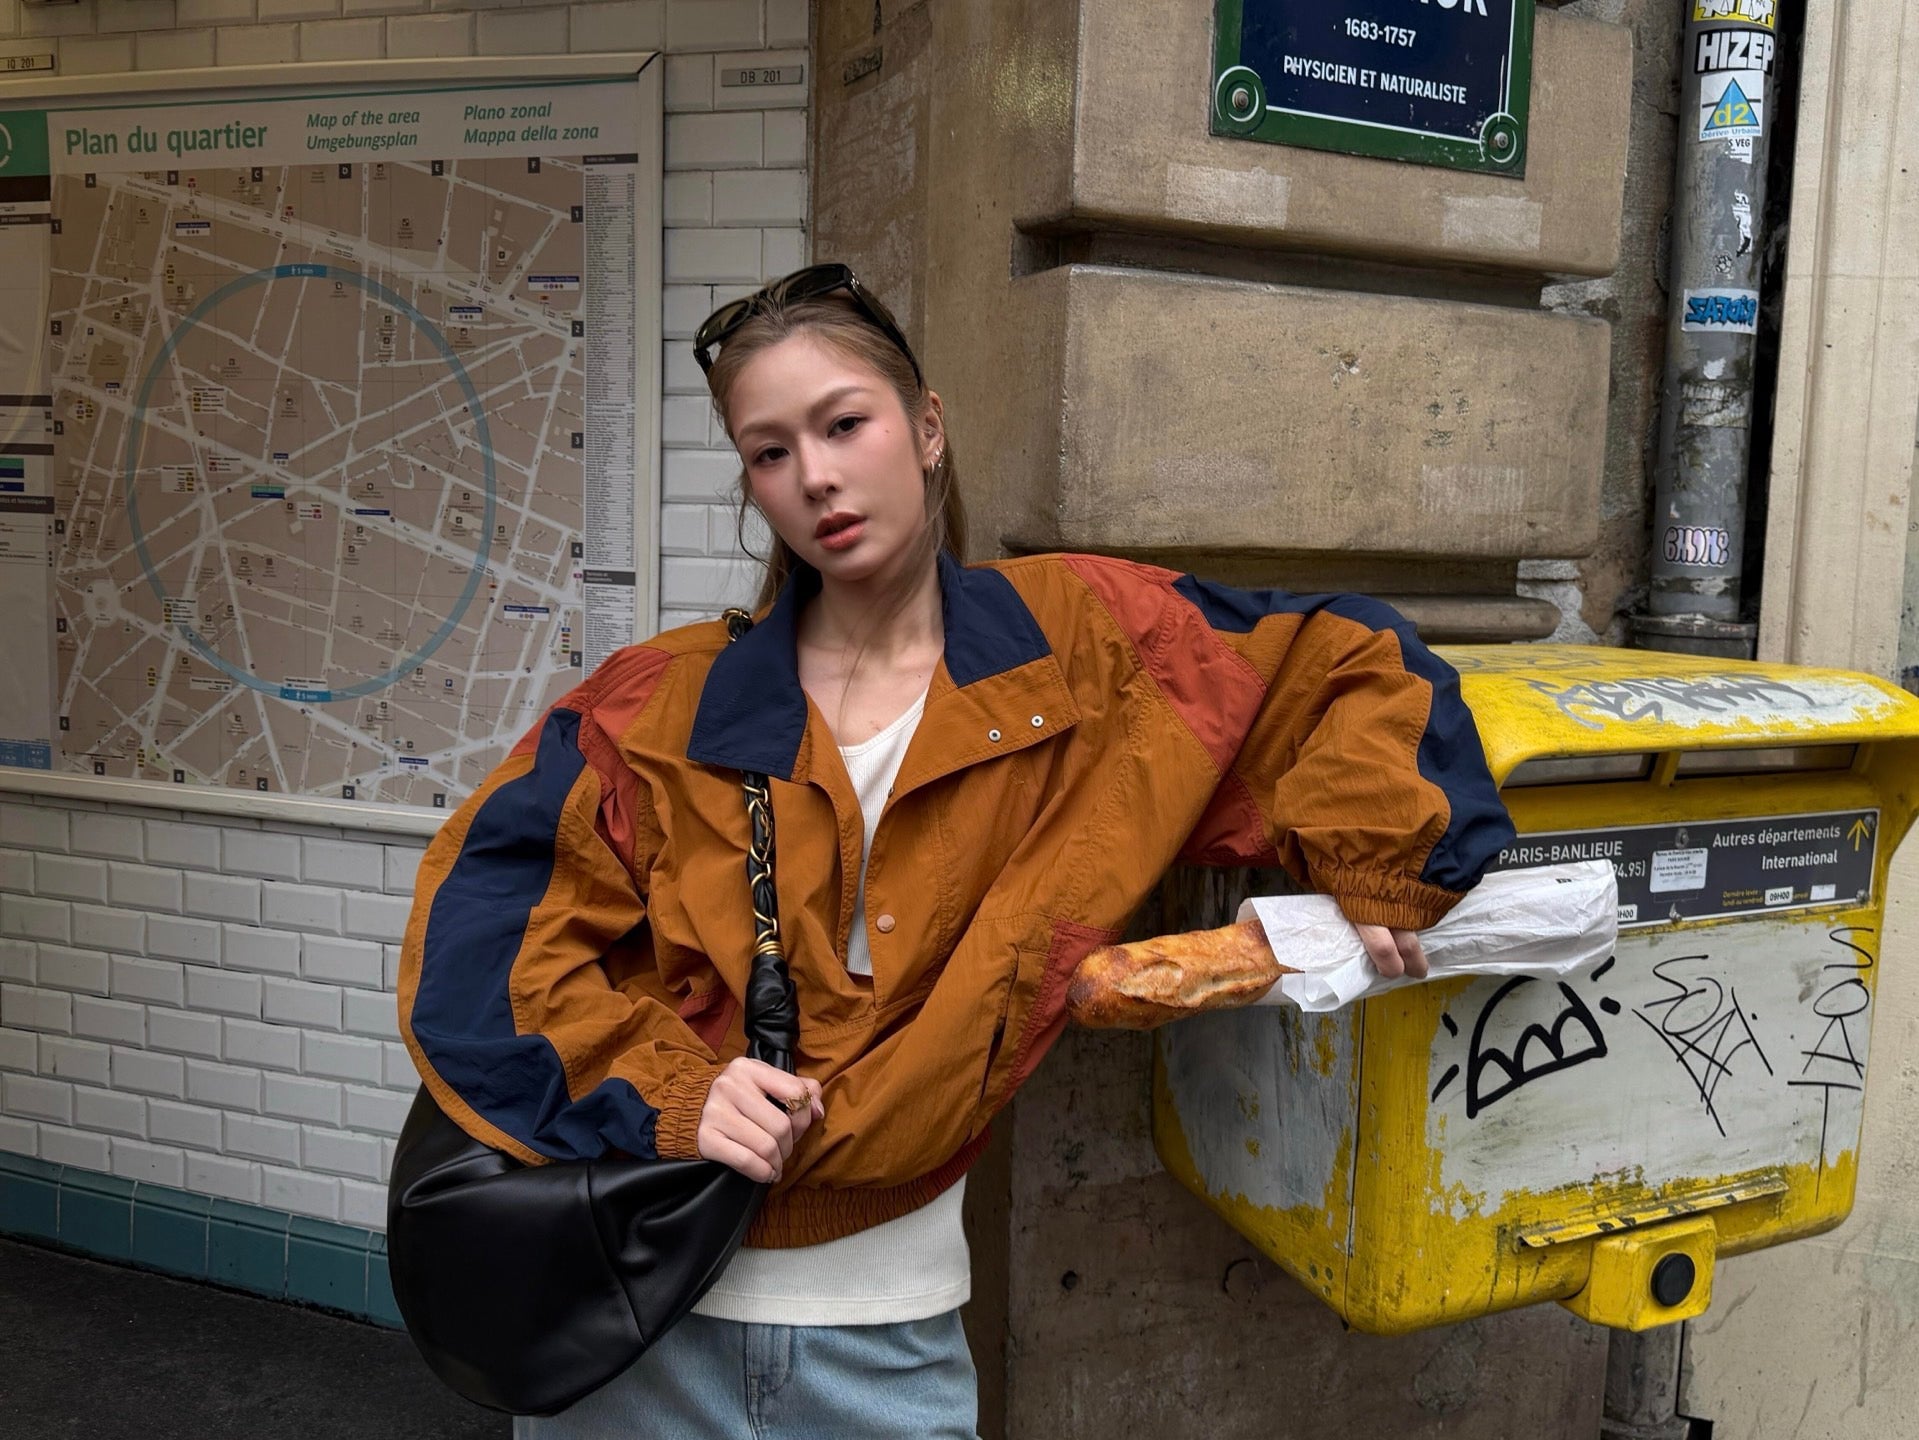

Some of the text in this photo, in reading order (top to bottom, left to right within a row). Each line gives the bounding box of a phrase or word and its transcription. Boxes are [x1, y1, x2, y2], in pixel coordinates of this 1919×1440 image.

[1344, 18, 1416, 48] 1683-1757
[20, 56, 34, 68] 201
[1697, 31, 1774, 72] HIZEP
[740, 70, 780, 84] DB 201
[1283, 55, 1466, 105] PHYSICIEN ET NATURALISTE
[306, 110, 420, 130] Map of the area
[464, 102, 552, 121] Plano zonal
[1713, 103, 1750, 127] d2
[66, 120, 268, 159] Plan du quartier
[306, 132, 418, 153] Umgebungsplan
[464, 126, 600, 147] Mappa della zona
[1712, 825, 1841, 848] Autres départements
[1498, 840, 1624, 864] PARIS-BANLIEUE
[1762, 850, 1838, 871] International
[1769, 891, 1790, 902] 09H00
